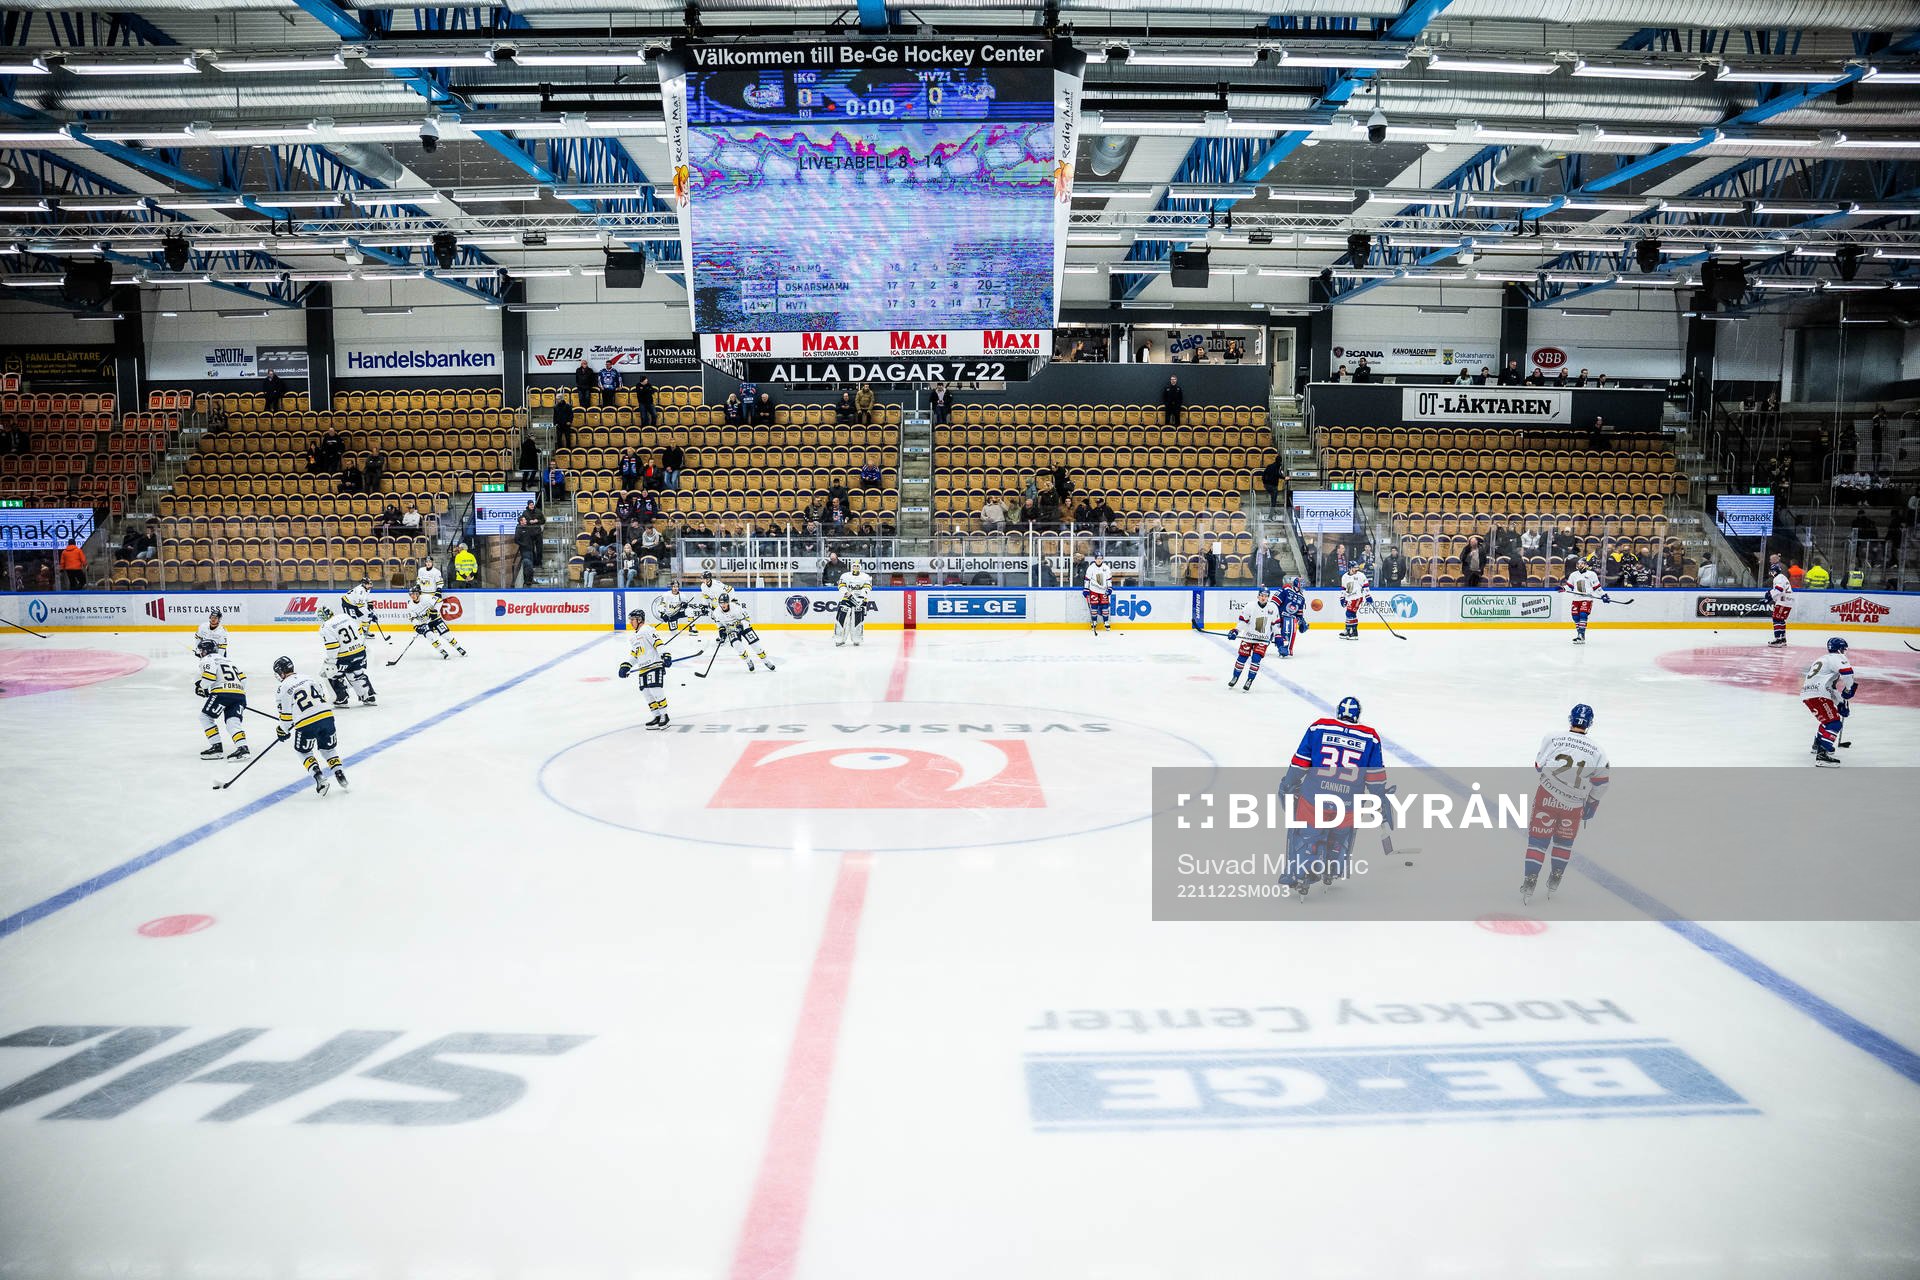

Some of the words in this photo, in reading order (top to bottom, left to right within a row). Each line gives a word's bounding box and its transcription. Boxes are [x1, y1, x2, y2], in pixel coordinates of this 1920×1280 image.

[693, 49, 805, 66] Välkommen
[811, 47, 834, 63] till
[840, 46, 898, 63] Be-Ge
[904, 45, 975, 66] Hockey
[981, 45, 1044, 62] Center
[799, 88, 813, 106] 0
[928, 87, 943, 105] 0
[846, 99, 895, 116] 0:00
[800, 155, 893, 170] LIVETABELL
[899, 155, 907, 169] 8
[924, 155, 943, 168] 14
[887, 281, 898, 290] 17
[930, 281, 936, 290] 2
[977, 280, 992, 290] 20
[887, 300, 898, 308] 17
[910, 300, 915, 308] 3
[930, 300, 936, 308] 2
[977, 298, 991, 308] 17
[715, 333, 772, 352] MAXI
[802, 332, 859, 351] MAXI
[890, 331, 947, 349] MAXI
[983, 330, 1040, 348] MAXI
[214, 348, 244, 363] GROTH
[348, 349, 495, 369] Handelsbanken
[547, 347, 584, 359] EPAB
[1345, 350, 1384, 358] SCANIA
[1537, 352, 1562, 364] SBB
[769, 364, 841, 382] ALLA
[848, 363, 945, 381] DAGAR
[951, 362, 1005, 381] 7-22
[1419, 392, 1552, 416] OT-LÄKTAREN
[488, 510, 524, 520] formak
[1306, 508, 1352, 518] formakök
[1728, 512, 1772, 522] formakök
[947, 558, 1028, 572] Liljeholmens
[937, 600, 1017, 613] BE-GE
[1110, 594, 1152, 621] lajo
[1465, 596, 1505, 605] GodsService
[1506, 597, 1517, 606] AB
[1706, 602, 1775, 613] HYDROSCAN
[1830, 599, 1890, 615] SAMUELSSONS
[50, 606, 127, 614] HAMMARSTEDTS
[507, 602, 590, 616] Bergkvarabuss
[1359, 606, 1395, 614] CENTRUM
[1469, 606, 1511, 616] Oskarshamn
[1839, 613, 1863, 623] TAK
[1864, 614, 1879, 623] AB
[338, 625, 358, 645] 31
[294, 685, 327, 712] 24
[670, 723, 808, 734] SPEL
[831, 722, 1112, 734] SVENSKA
[1325, 735, 1363, 749] BE-GE
[1317, 746, 1362, 782] 35
[1552, 753, 1586, 789] 21
[1320, 780, 1351, 794] CANNATA
[1333, 997, 1638, 1028] Hockey
[1025, 1006, 1312, 1034] Center
